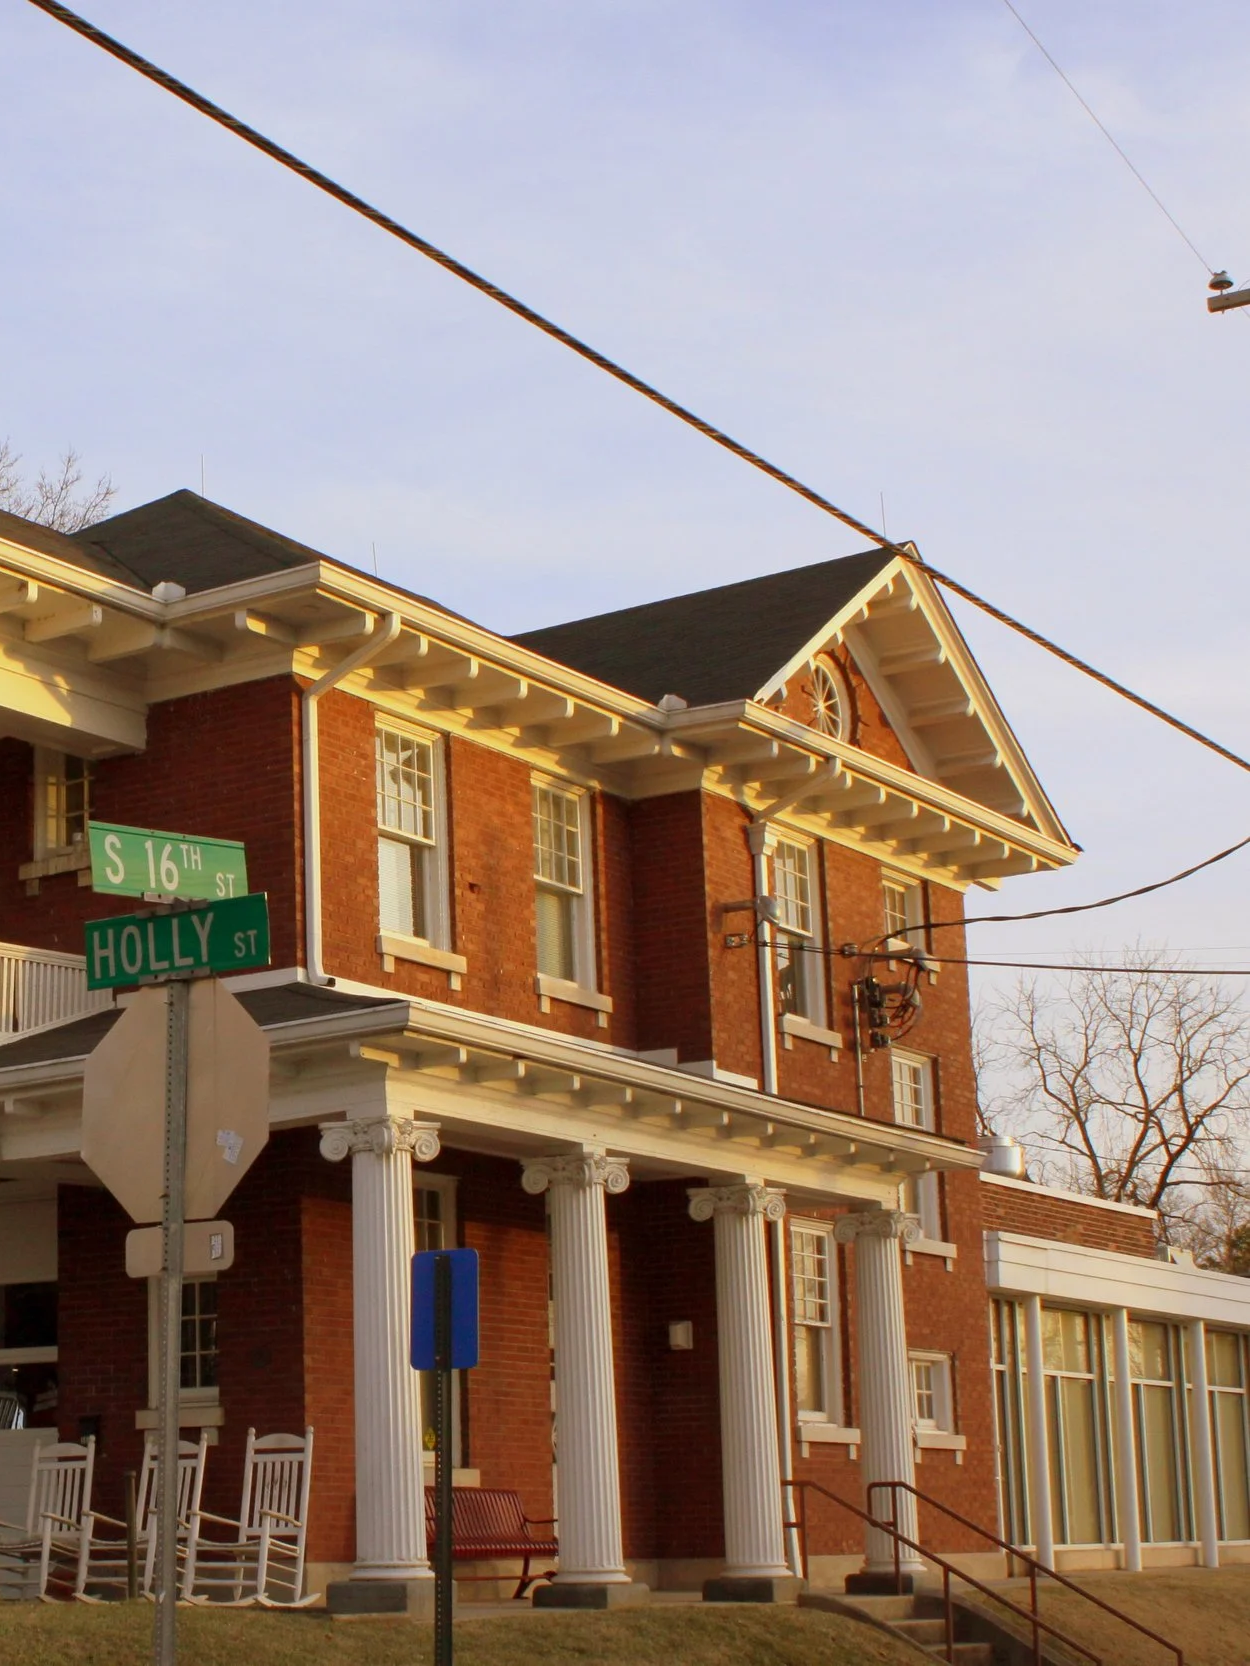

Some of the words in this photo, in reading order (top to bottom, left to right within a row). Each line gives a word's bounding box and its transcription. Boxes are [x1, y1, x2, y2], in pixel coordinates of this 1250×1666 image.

[104, 834, 125, 884] S
[145, 840, 202, 891] 16TH
[216, 872, 235, 898] ST
[93, 912, 214, 979] HOLLY
[234, 930, 257, 958] ST
